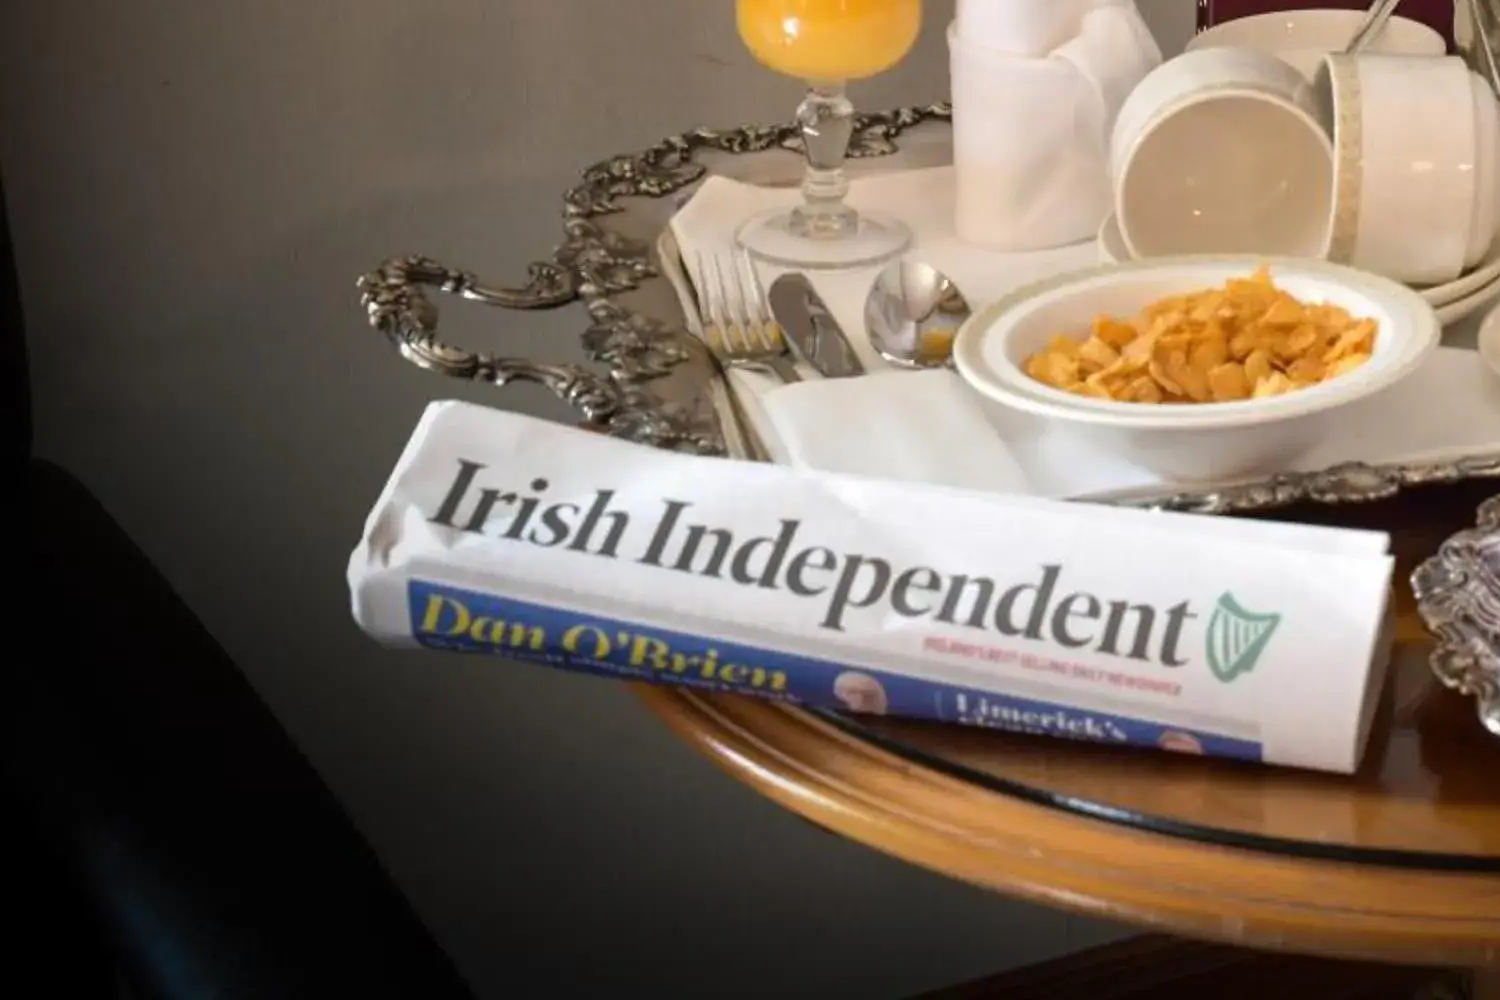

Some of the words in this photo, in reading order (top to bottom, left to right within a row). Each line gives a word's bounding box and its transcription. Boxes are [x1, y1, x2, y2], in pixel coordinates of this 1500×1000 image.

[427, 457, 631, 560] Irish
[637, 497, 1199, 669] Independent
[420, 593, 546, 651] Dan
[562, 624, 787, 691] O'Brien
[955, 693, 1128, 743] Limerick's
